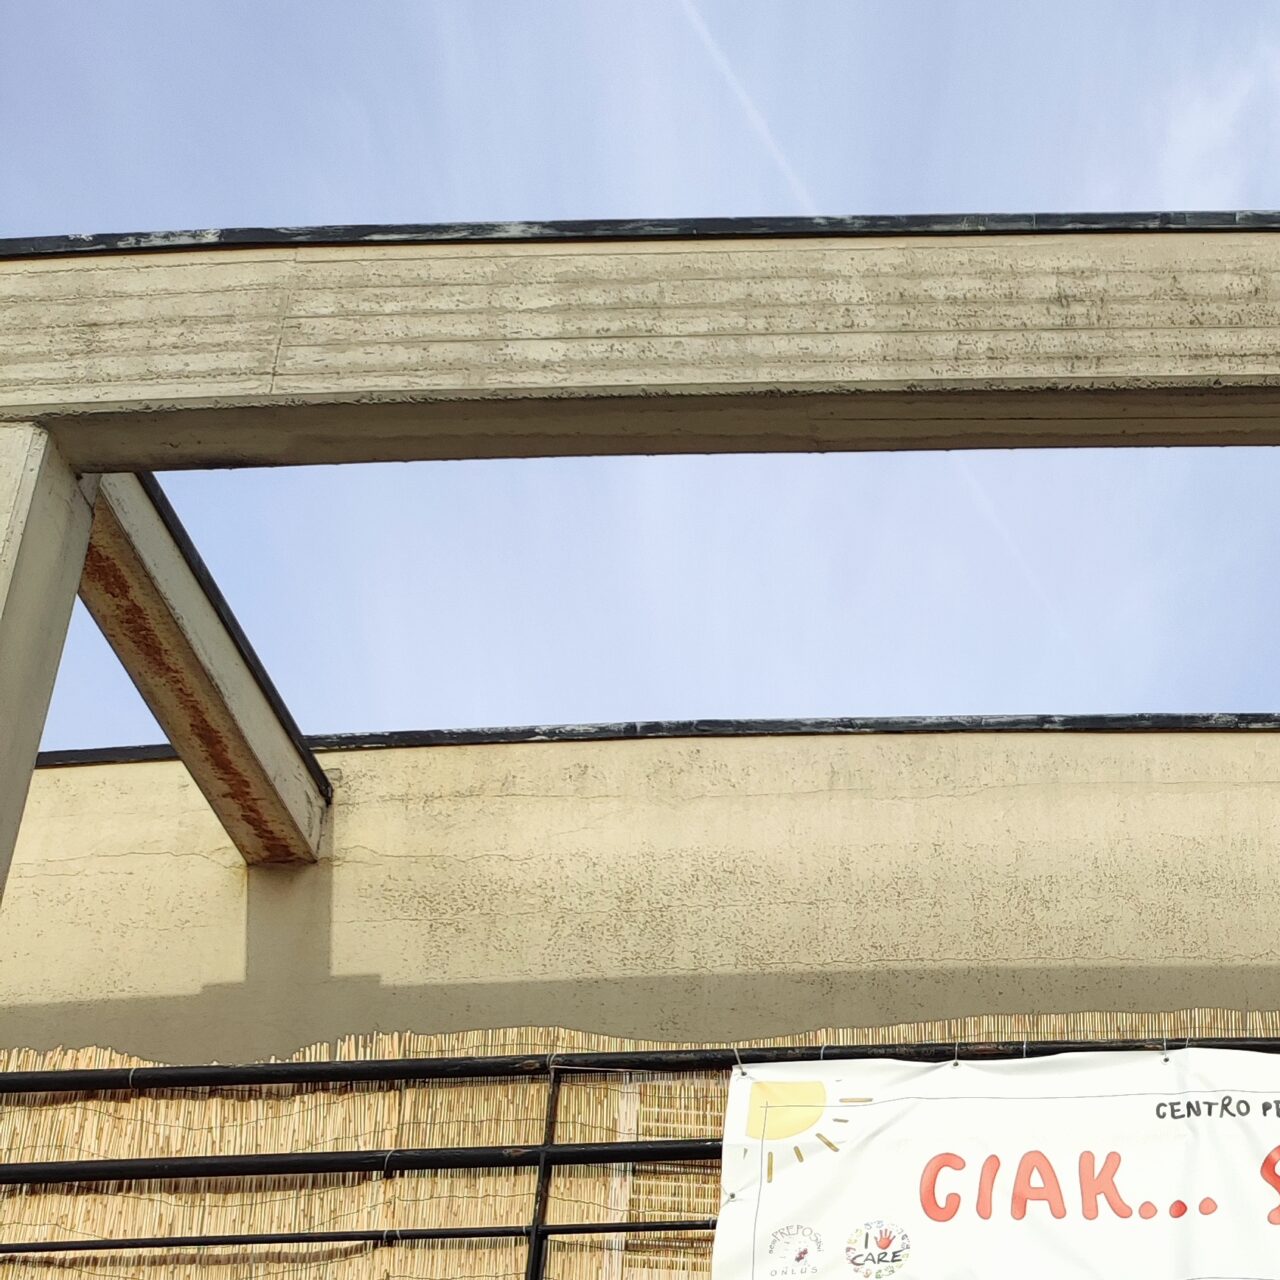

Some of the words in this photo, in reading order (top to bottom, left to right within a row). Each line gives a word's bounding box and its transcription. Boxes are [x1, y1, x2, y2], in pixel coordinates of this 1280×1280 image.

[1155, 1096, 1251, 1119] CENTRO
[850, 1249, 906, 1266] CARE
[770, 1265, 818, 1277] ONLUS
